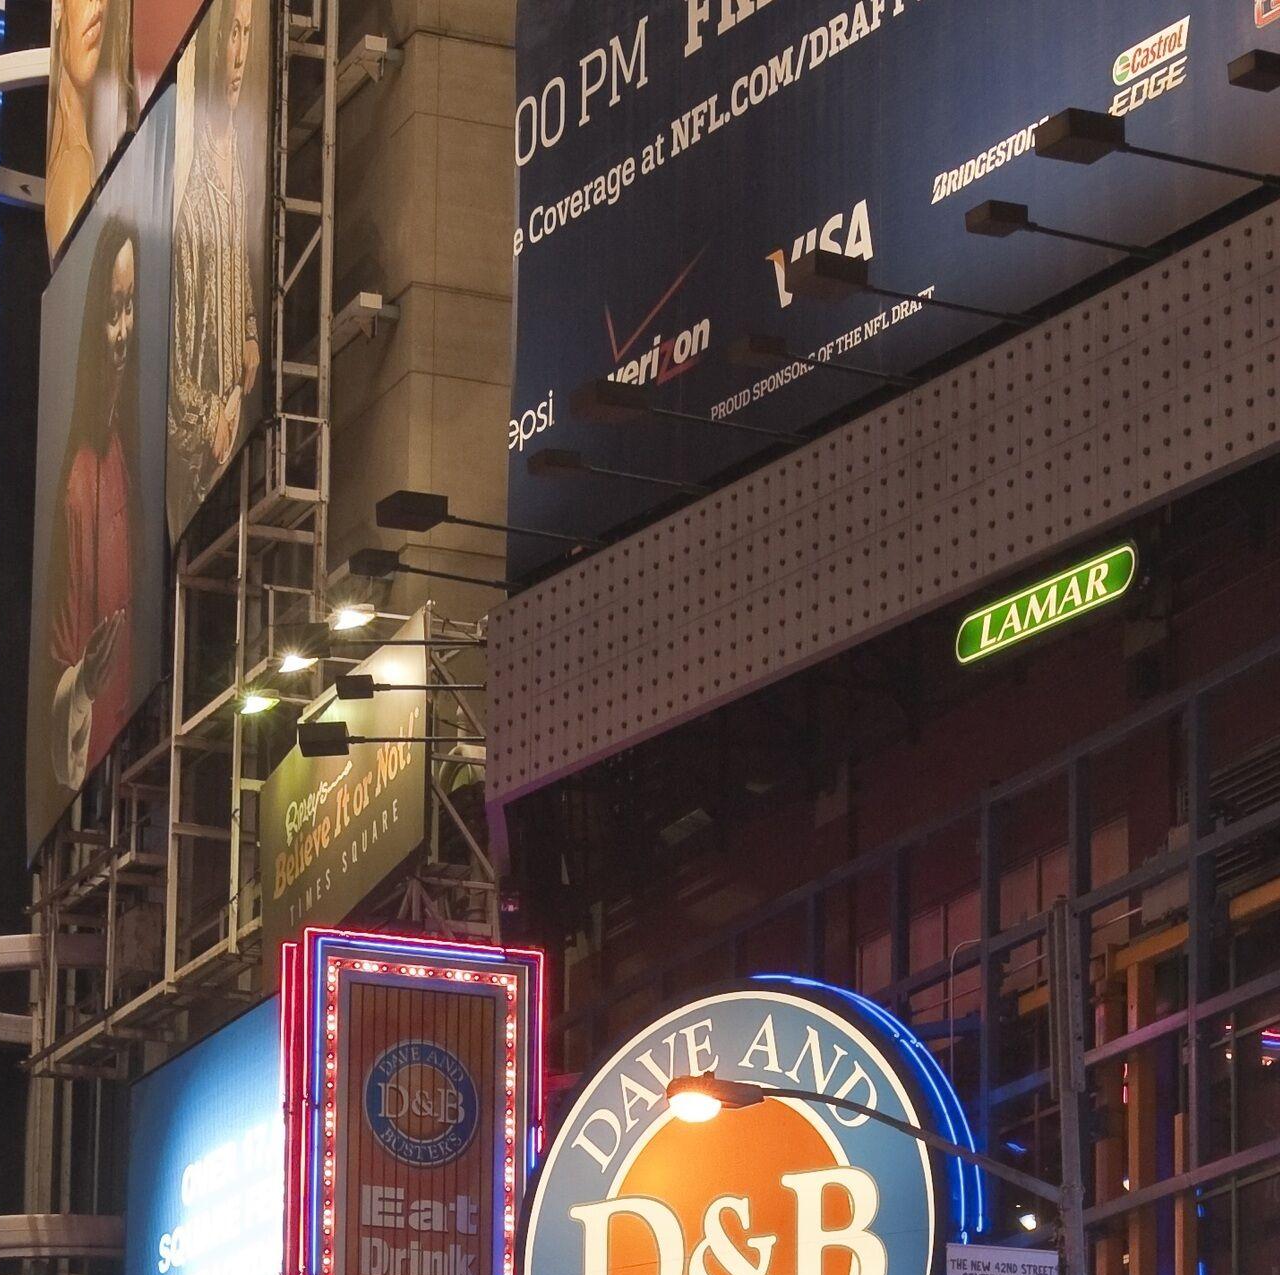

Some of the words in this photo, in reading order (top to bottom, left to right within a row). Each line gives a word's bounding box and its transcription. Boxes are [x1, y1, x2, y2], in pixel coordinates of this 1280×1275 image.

[578, 15, 649, 127] PM
[1107, 55, 1188, 116] EDGE
[1130, 22, 1184, 77] Castrol
[529, 156, 635, 244] Coverage
[640, 134, 665, 176] at
[931, 115, 1051, 205] BRIDGESTO
[607, 318, 710, 387] verizon
[710, 390, 750, 422] PROUD
[752, 353, 816, 402] SPONSORS
[817, 341, 835, 363] OF
[835, 325, 861, 352] THE
[864, 310, 889, 339] NFL
[980, 562, 1109, 649] LAMAR
[274, 816, 331, 900] Believe
[335, 785, 350, 838] It
[353, 774, 373, 817] or
[290, 868, 332, 927] TIMES
[341, 798, 399, 873] SQUARE
[377, 1082, 465, 1125] D&B
[380, 1046, 419, 1078] DAVE
[426, 1051, 464, 1084] AND
[571, 1018, 719, 1175] DAVE
[738, 1013, 878, 1127] AND
[362, 1184, 478, 1234] Eat
[950, 1258, 967, 1270] THE
[971, 1260, 990, 1272] NEW
[995, 1262, 1018, 1274] 42ND
[1021, 1264, 1054, 1275] STREET
